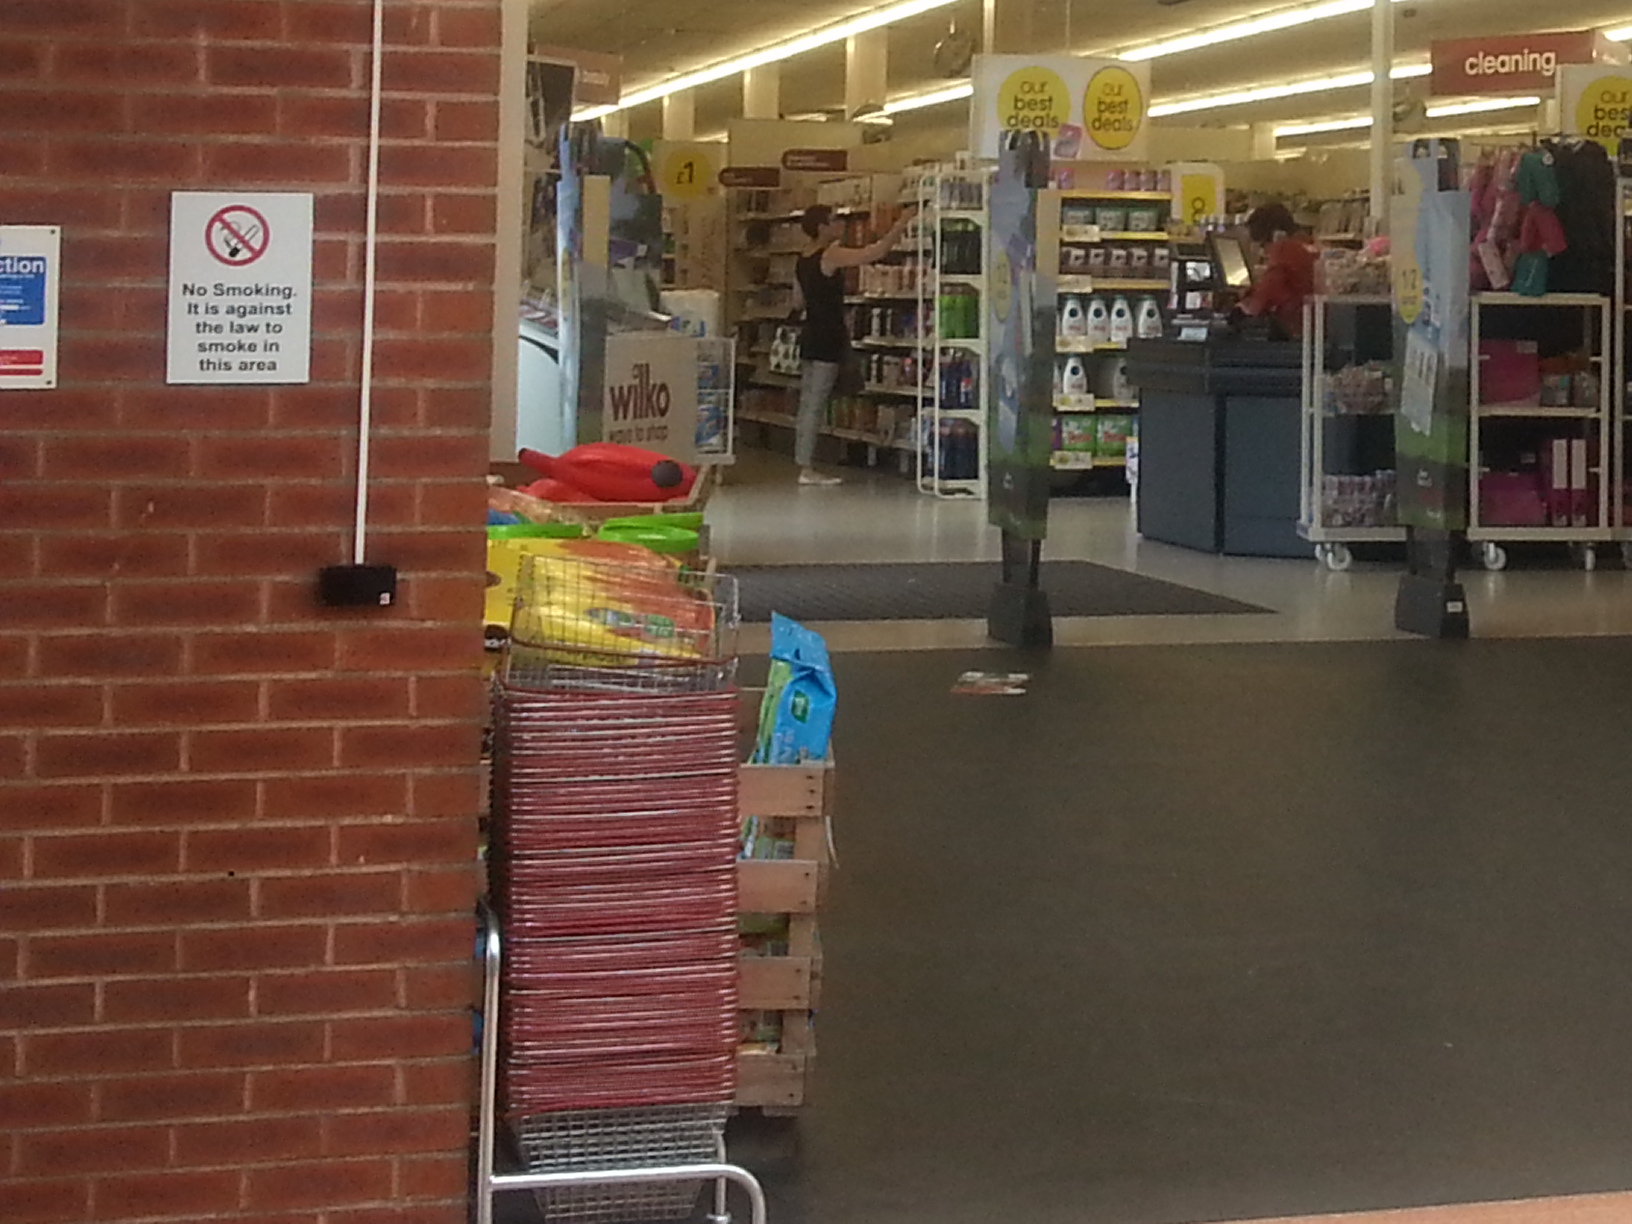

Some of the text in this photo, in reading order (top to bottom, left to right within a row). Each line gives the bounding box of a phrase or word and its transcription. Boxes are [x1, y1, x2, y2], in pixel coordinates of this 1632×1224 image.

[1465, 49, 1556, 75] cleaning
[1020, 81, 1048, 94] our
[1102, 82, 1124, 96] our
[1014, 95, 1053, 111] best
[1600, 90, 1629, 104] our
[1097, 97, 1128, 115] best
[1594, 105, 1632, 121] bes
[1007, 113, 1059, 128] deals
[1091, 116, 1134, 132] deals
[676, 161, 694, 185] £1
[182, 282, 297, 300] No Smoking.
[187, 302, 292, 318] It is against
[195, 321, 283, 334] the law to
[198, 339, 280, 353] smoke in
[199, 358, 277, 372] this area
[609, 363, 670, 421] wilko
